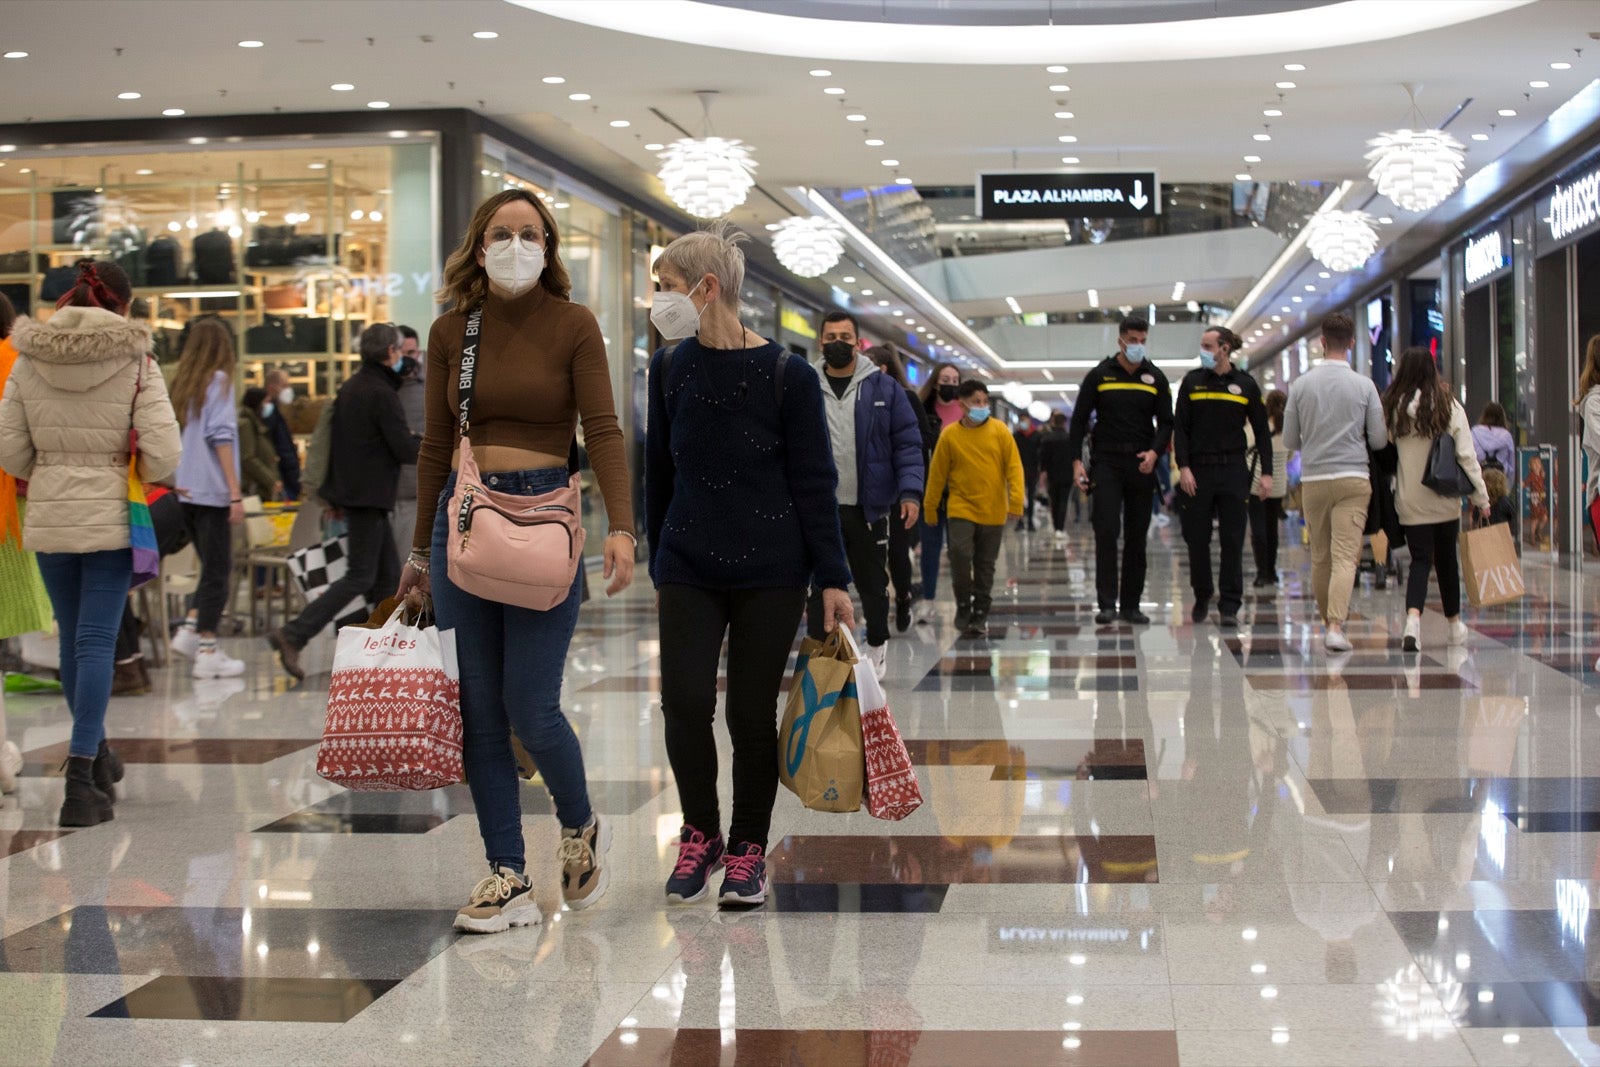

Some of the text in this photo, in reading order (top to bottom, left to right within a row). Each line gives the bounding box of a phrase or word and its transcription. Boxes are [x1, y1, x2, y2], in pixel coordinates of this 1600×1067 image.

[993, 188, 1124, 203] PLAZA ALHAMBRA
[459, 344, 477, 389] BIMBA
[1475, 562, 1525, 600] ZARA
